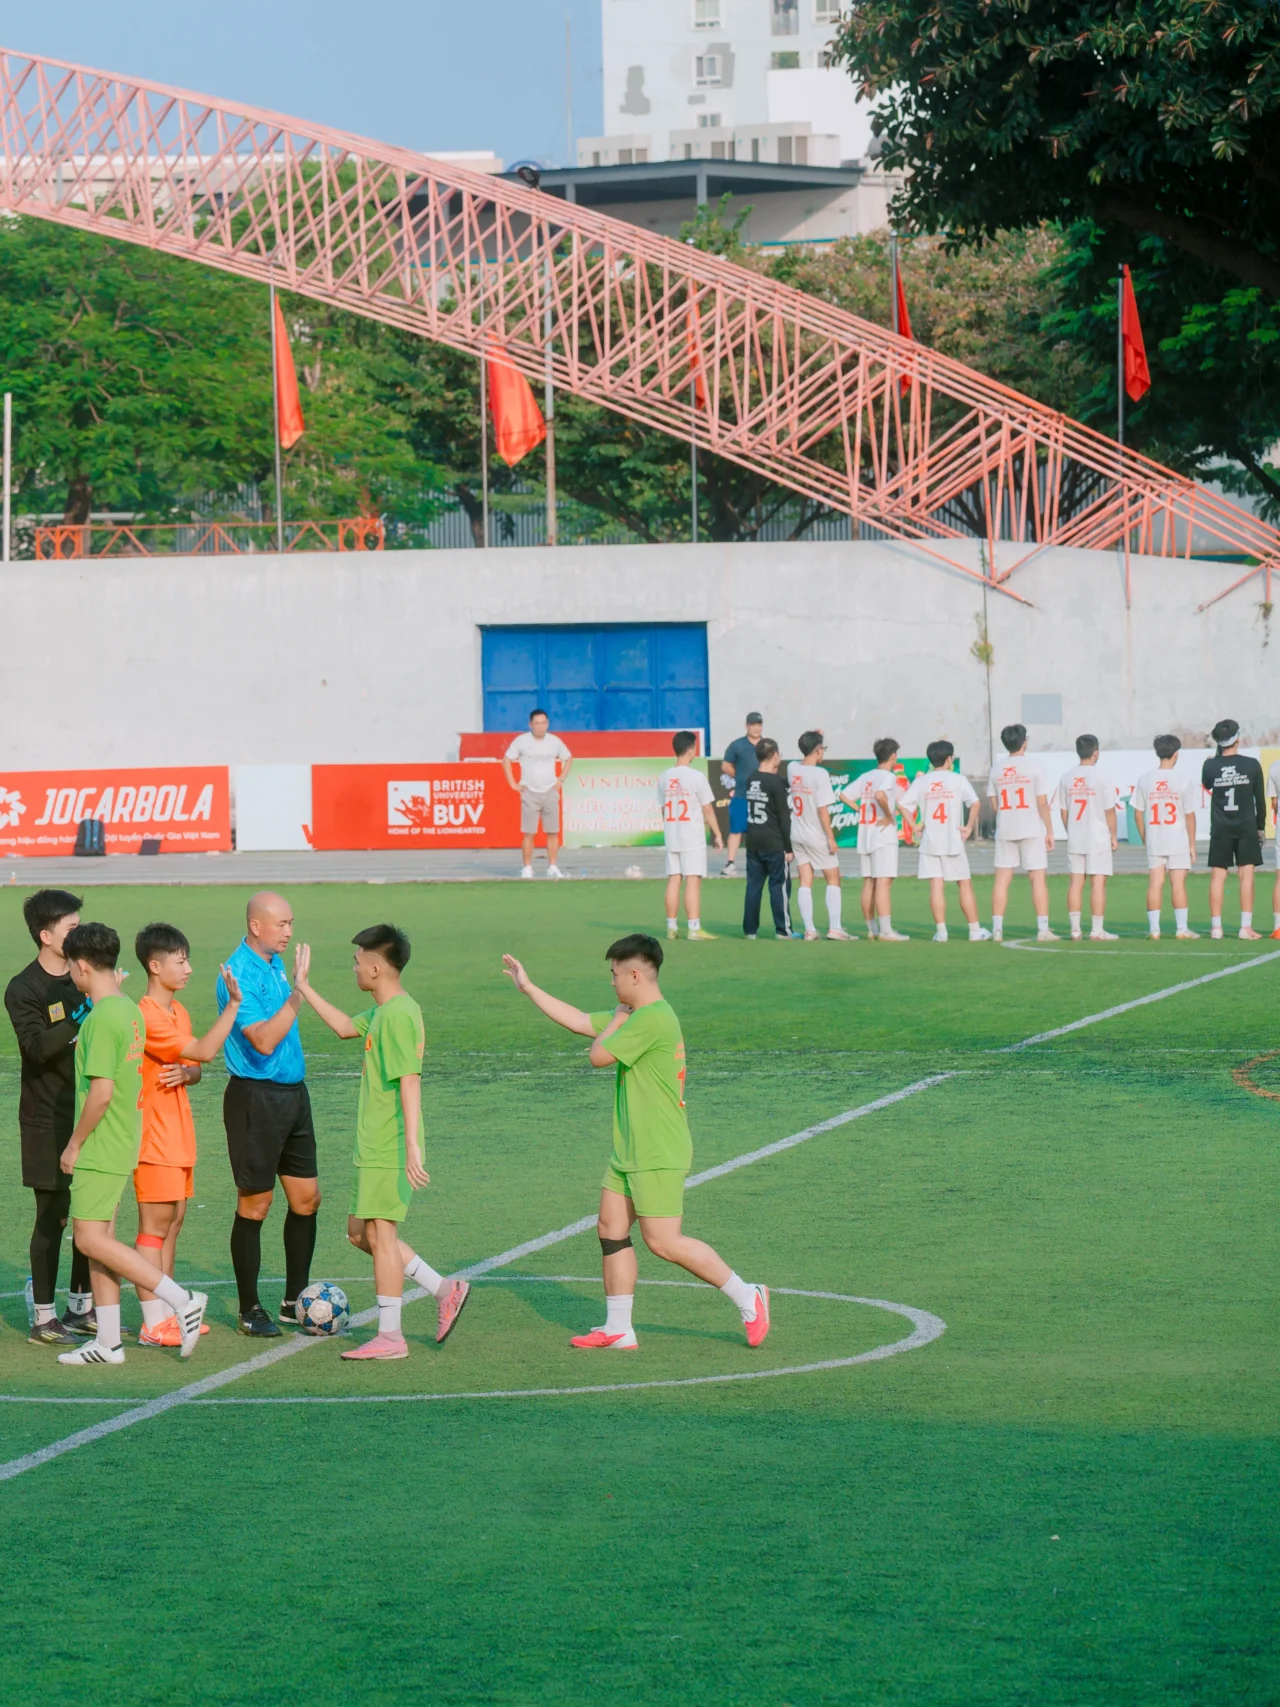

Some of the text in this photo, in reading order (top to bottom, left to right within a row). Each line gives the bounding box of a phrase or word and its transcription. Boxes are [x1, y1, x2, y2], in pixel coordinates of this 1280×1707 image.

[433, 780, 484, 791] BRITISH
[433, 791, 484, 799] UNIVERSITY
[34, 784, 214, 825] JOGARBOLA
[793, 796, 803, 817] 9
[1000, 787, 1029, 810] 11
[1223, 788, 1239, 811] 1
[433, 804, 484, 825] BUV
[665, 799, 691, 821] 12
[932, 803, 947, 824] 4
[1074, 799, 1087, 821] 7
[1149, 802, 1177, 825] 13
